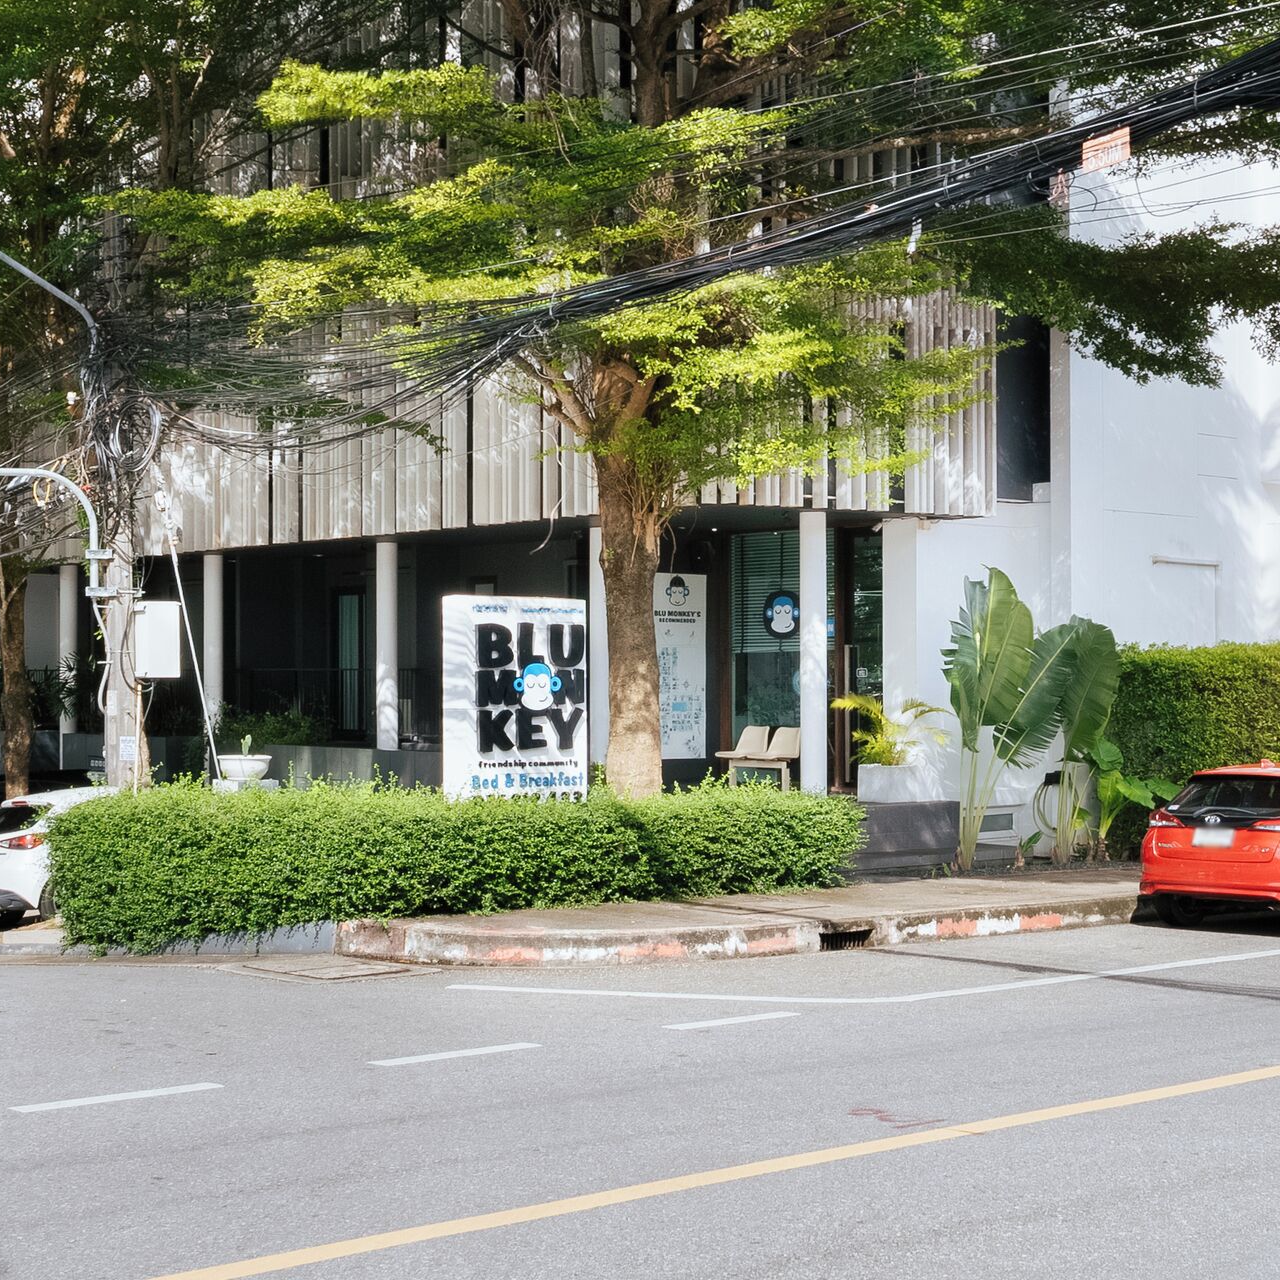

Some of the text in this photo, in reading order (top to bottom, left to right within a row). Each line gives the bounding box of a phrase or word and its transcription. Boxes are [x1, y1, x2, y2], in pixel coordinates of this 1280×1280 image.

[475, 622, 585, 670] BLU
[475, 668, 585, 708] MN
[477, 706, 585, 753] KEY
[471, 770, 584, 790] Bed & Breakfast
[478, 758, 579, 770] friendship community
